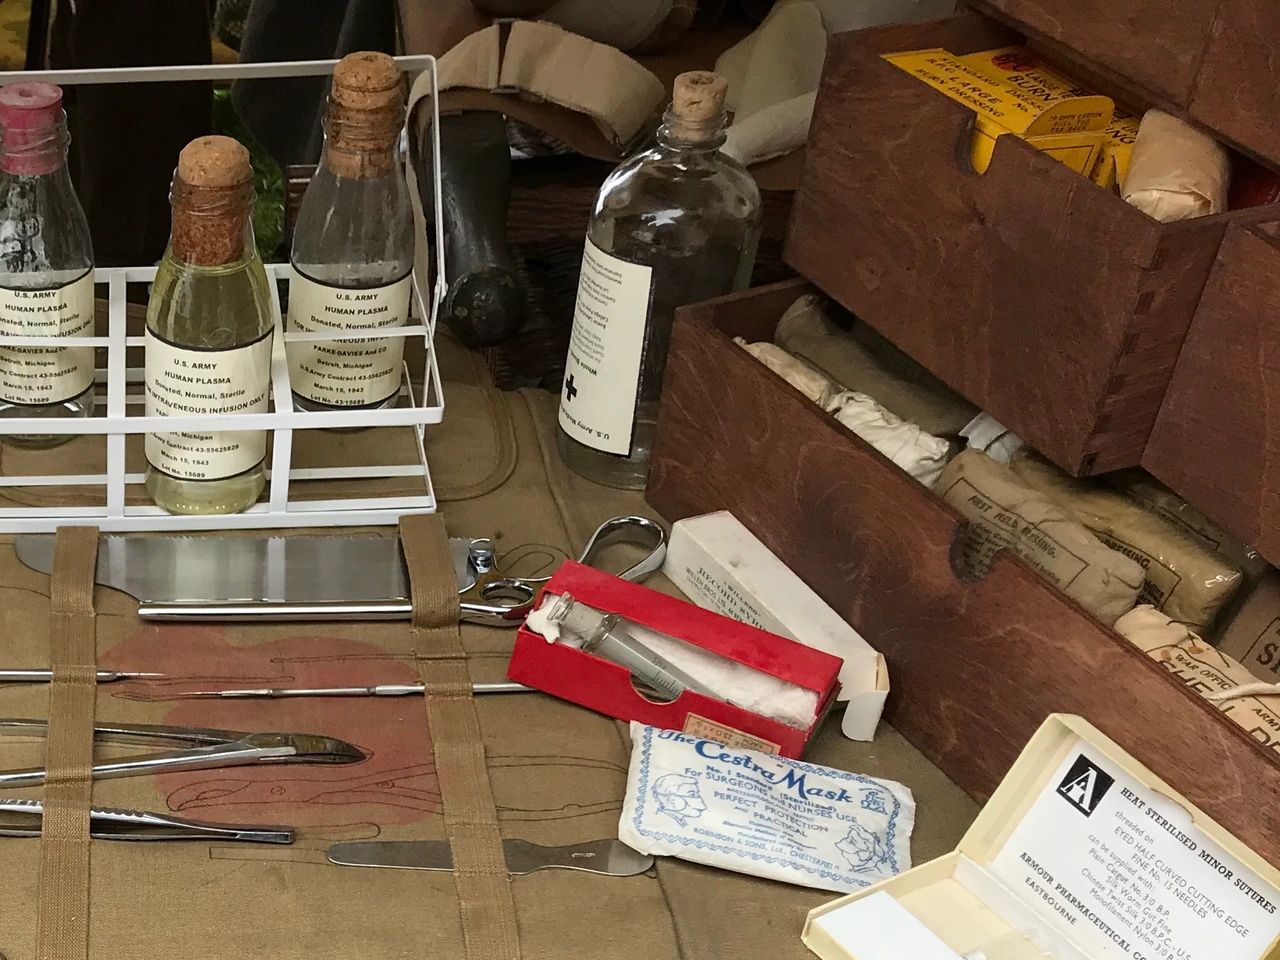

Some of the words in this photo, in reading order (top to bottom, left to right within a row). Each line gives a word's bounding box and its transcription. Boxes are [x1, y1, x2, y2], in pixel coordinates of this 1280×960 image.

[1007, 75, 1058, 102] BURN
[5, 304, 35, 313] HUMAN
[37, 303, 68, 313] PLASMA
[14, 291, 31, 299] U.S.
[32, 291, 56, 299] ARMY
[336, 293, 352, 301] U.S.
[354, 293, 379, 301] ARMY
[27, 319, 58, 328] Normal,
[310, 315, 343, 330] Donated,
[345, 322, 377, 330] Normal,
[325, 305, 356, 315] HUMAN
[357, 305, 389, 316] PLASMA
[173, 358, 189, 368] U.S.
[191, 362, 218, 370] ARMY
[327, 373, 357, 381] Contract
[154, 379, 183, 396] Donated,
[184, 391, 218, 400] Normal,
[219, 389, 246, 399] Sterile
[164, 370, 194, 384] HUMAN
[195, 377, 232, 385] PLASMA
[209, 402, 249, 415] INFUSION
[249, 393, 266, 407] ONLY
[166, 440, 194, 452] Contract
[180, 431, 214, 441] Michigan
[160, 449, 178, 461] March
[967, 495, 993, 512] FIRST
[1174, 653, 1200, 672] WAR
[657, 731, 696, 745] The
[694, 739, 777, 782] Cestra
[768, 768, 854, 804] Mask
[706, 765, 721, 774] No.
[735, 772, 773, 792] Standard
[684, 767, 703, 778] For
[705, 772, 768, 797] SURGEONS
[788, 801, 834, 820] NURSES
[835, 813, 858, 824] USE
[713, 790, 759, 808] PERFECT
[764, 804, 830, 833] PROTECTION
[753, 811, 809, 838] PRACTICAL
[693, 827, 735, 843] ROBINSON
[743, 838, 768, 852] SONS,
[1114, 810, 1145, 838] threaded
[1143, 834, 1155, 845] on
[1087, 833, 1101, 846] can
[1099, 843, 1110, 854] be
[1109, 851, 1138, 877] supplied
[1120, 786, 1147, 810] HEAT
[1144, 806, 1198, 852] STERILISED
[1197, 849, 1234, 881] MINOR
[1233, 877, 1278, 915] SUTURES
[1088, 847, 1105, 865] Plain
[1105, 862, 1130, 885] Catgut
[1129, 882, 1143, 897] No.
[1155, 904, 1171, 920] B.P.
[1114, 825, 1135, 846] EYED
[1134, 841, 1157, 863] HALF
[1154, 859, 1188, 888] CURVED
[1187, 885, 1226, 919] CUTTING
[1223, 915, 1251, 938] EDGE
[1130, 853, 1152, 872] FINE
[1148, 867, 1162, 882] No.
[1172, 887, 1209, 919] NEEDLES
[1019, 851, 1055, 885] ARMOUR
[1054, 882, 1132, 953] PHARMACEUTICAL
[1024, 876, 1079, 926] EASTBOURNE
[1080, 867, 1107, 892] Chinese
[1106, 888, 1126, 910] Twist
[1124, 906, 1139, 921] Silk
[1150, 926, 1173, 949] B.P.C.
[1104, 875, 1119, 890] Silk
[1120, 888, 1143, 909] Worm
[1141, 906, 1157, 922] Gut
[1156, 918, 1173, 935] Fine
[1088, 887, 1134, 929] Monofilament
[1132, 924, 1155, 947] Nylon
